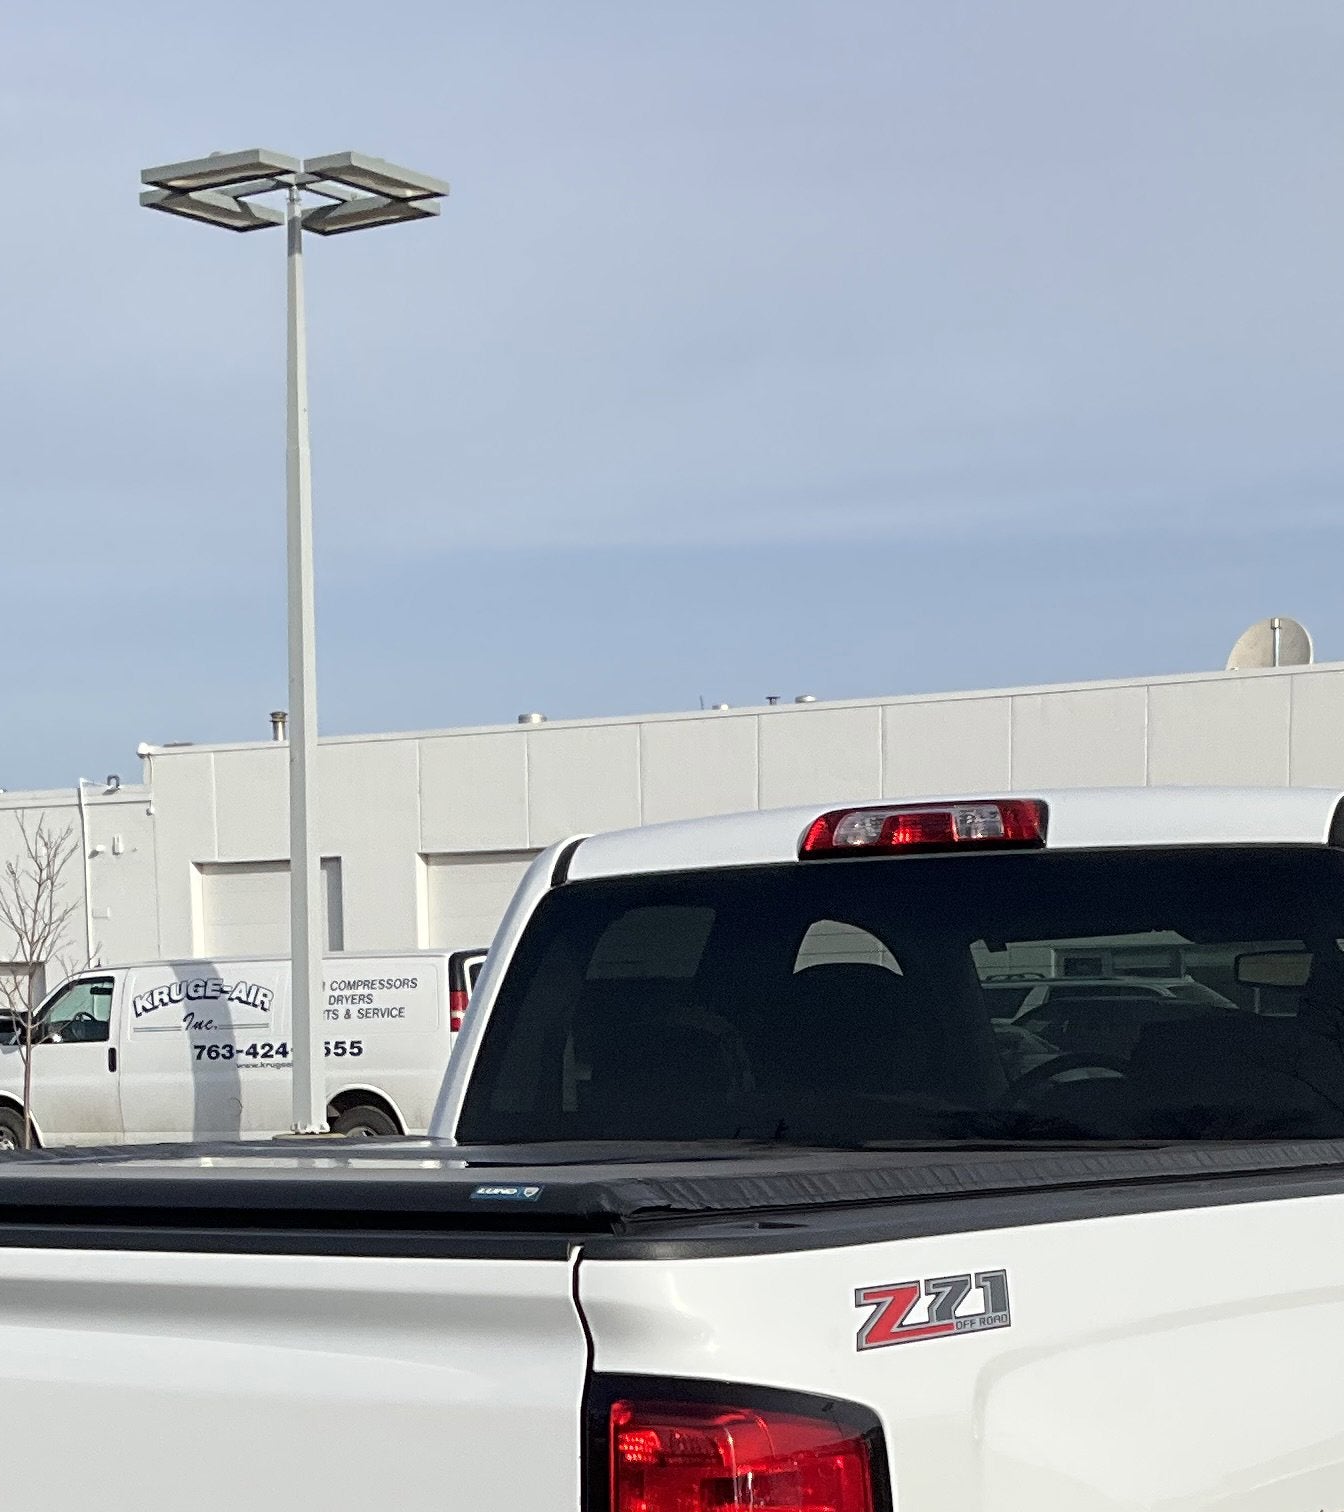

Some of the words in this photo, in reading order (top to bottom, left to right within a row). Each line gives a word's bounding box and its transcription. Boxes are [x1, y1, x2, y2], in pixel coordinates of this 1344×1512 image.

[330, 978, 418, 991] COMPRESSORS
[133, 978, 274, 1018] KRUGE-AIR
[328, 994, 373, 1006] DRYERS
[183, 1012, 218, 1031] Inc.
[344, 1009, 351, 1019] &
[357, 1007, 405, 1019] SERVICE
[854, 1269, 1011, 1352] Z71
[956, 1319, 976, 1330] OFF
[979, 1313, 1008, 1326] ROAD
